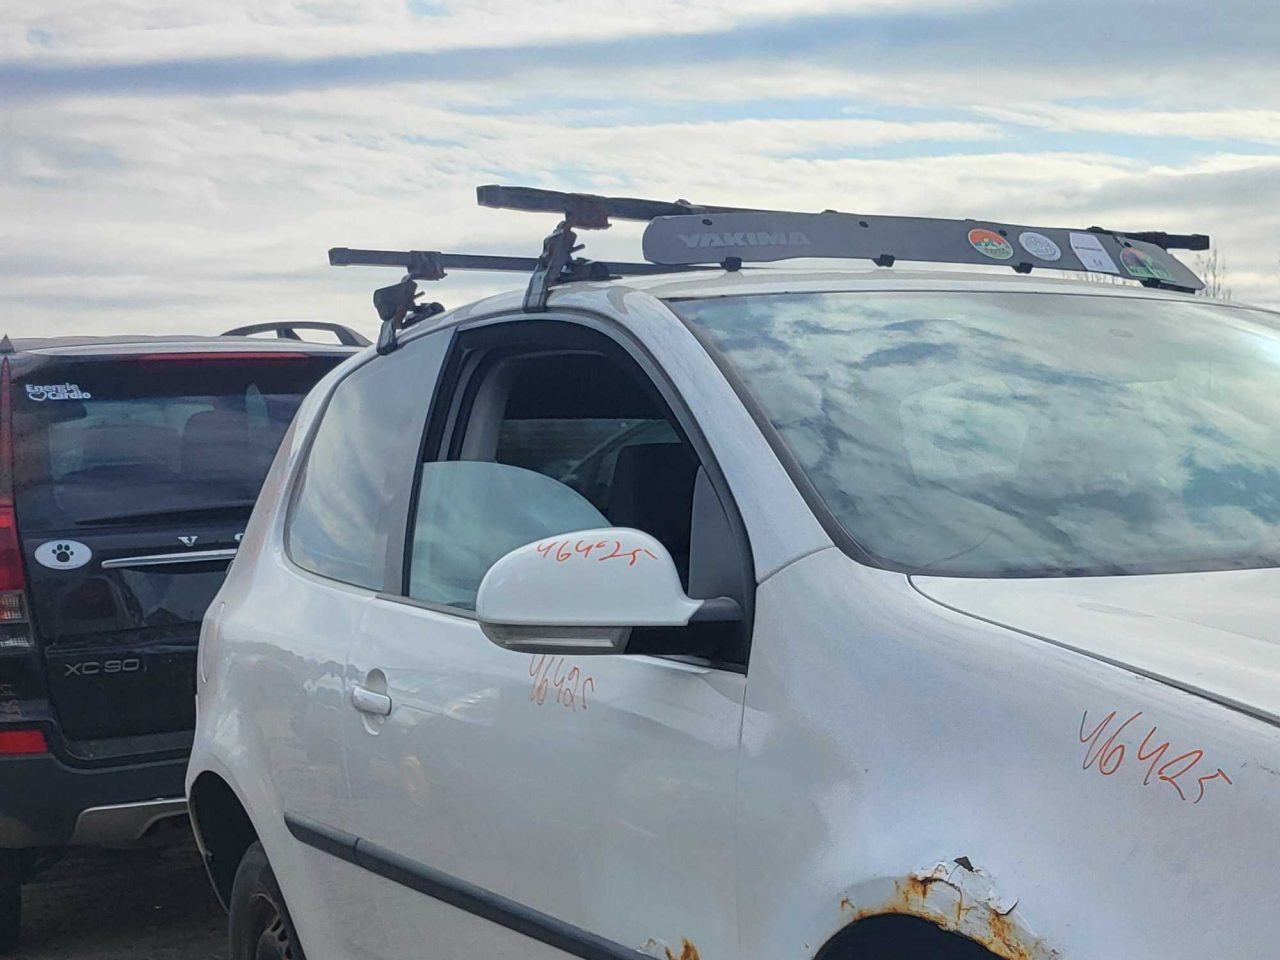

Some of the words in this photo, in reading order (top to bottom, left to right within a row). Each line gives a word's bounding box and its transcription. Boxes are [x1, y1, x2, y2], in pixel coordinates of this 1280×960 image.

[678, 231, 811, 248] YAKIMA
[47, 389, 92, 400] Cardio
[1080, 710, 1232, 804] 46425
